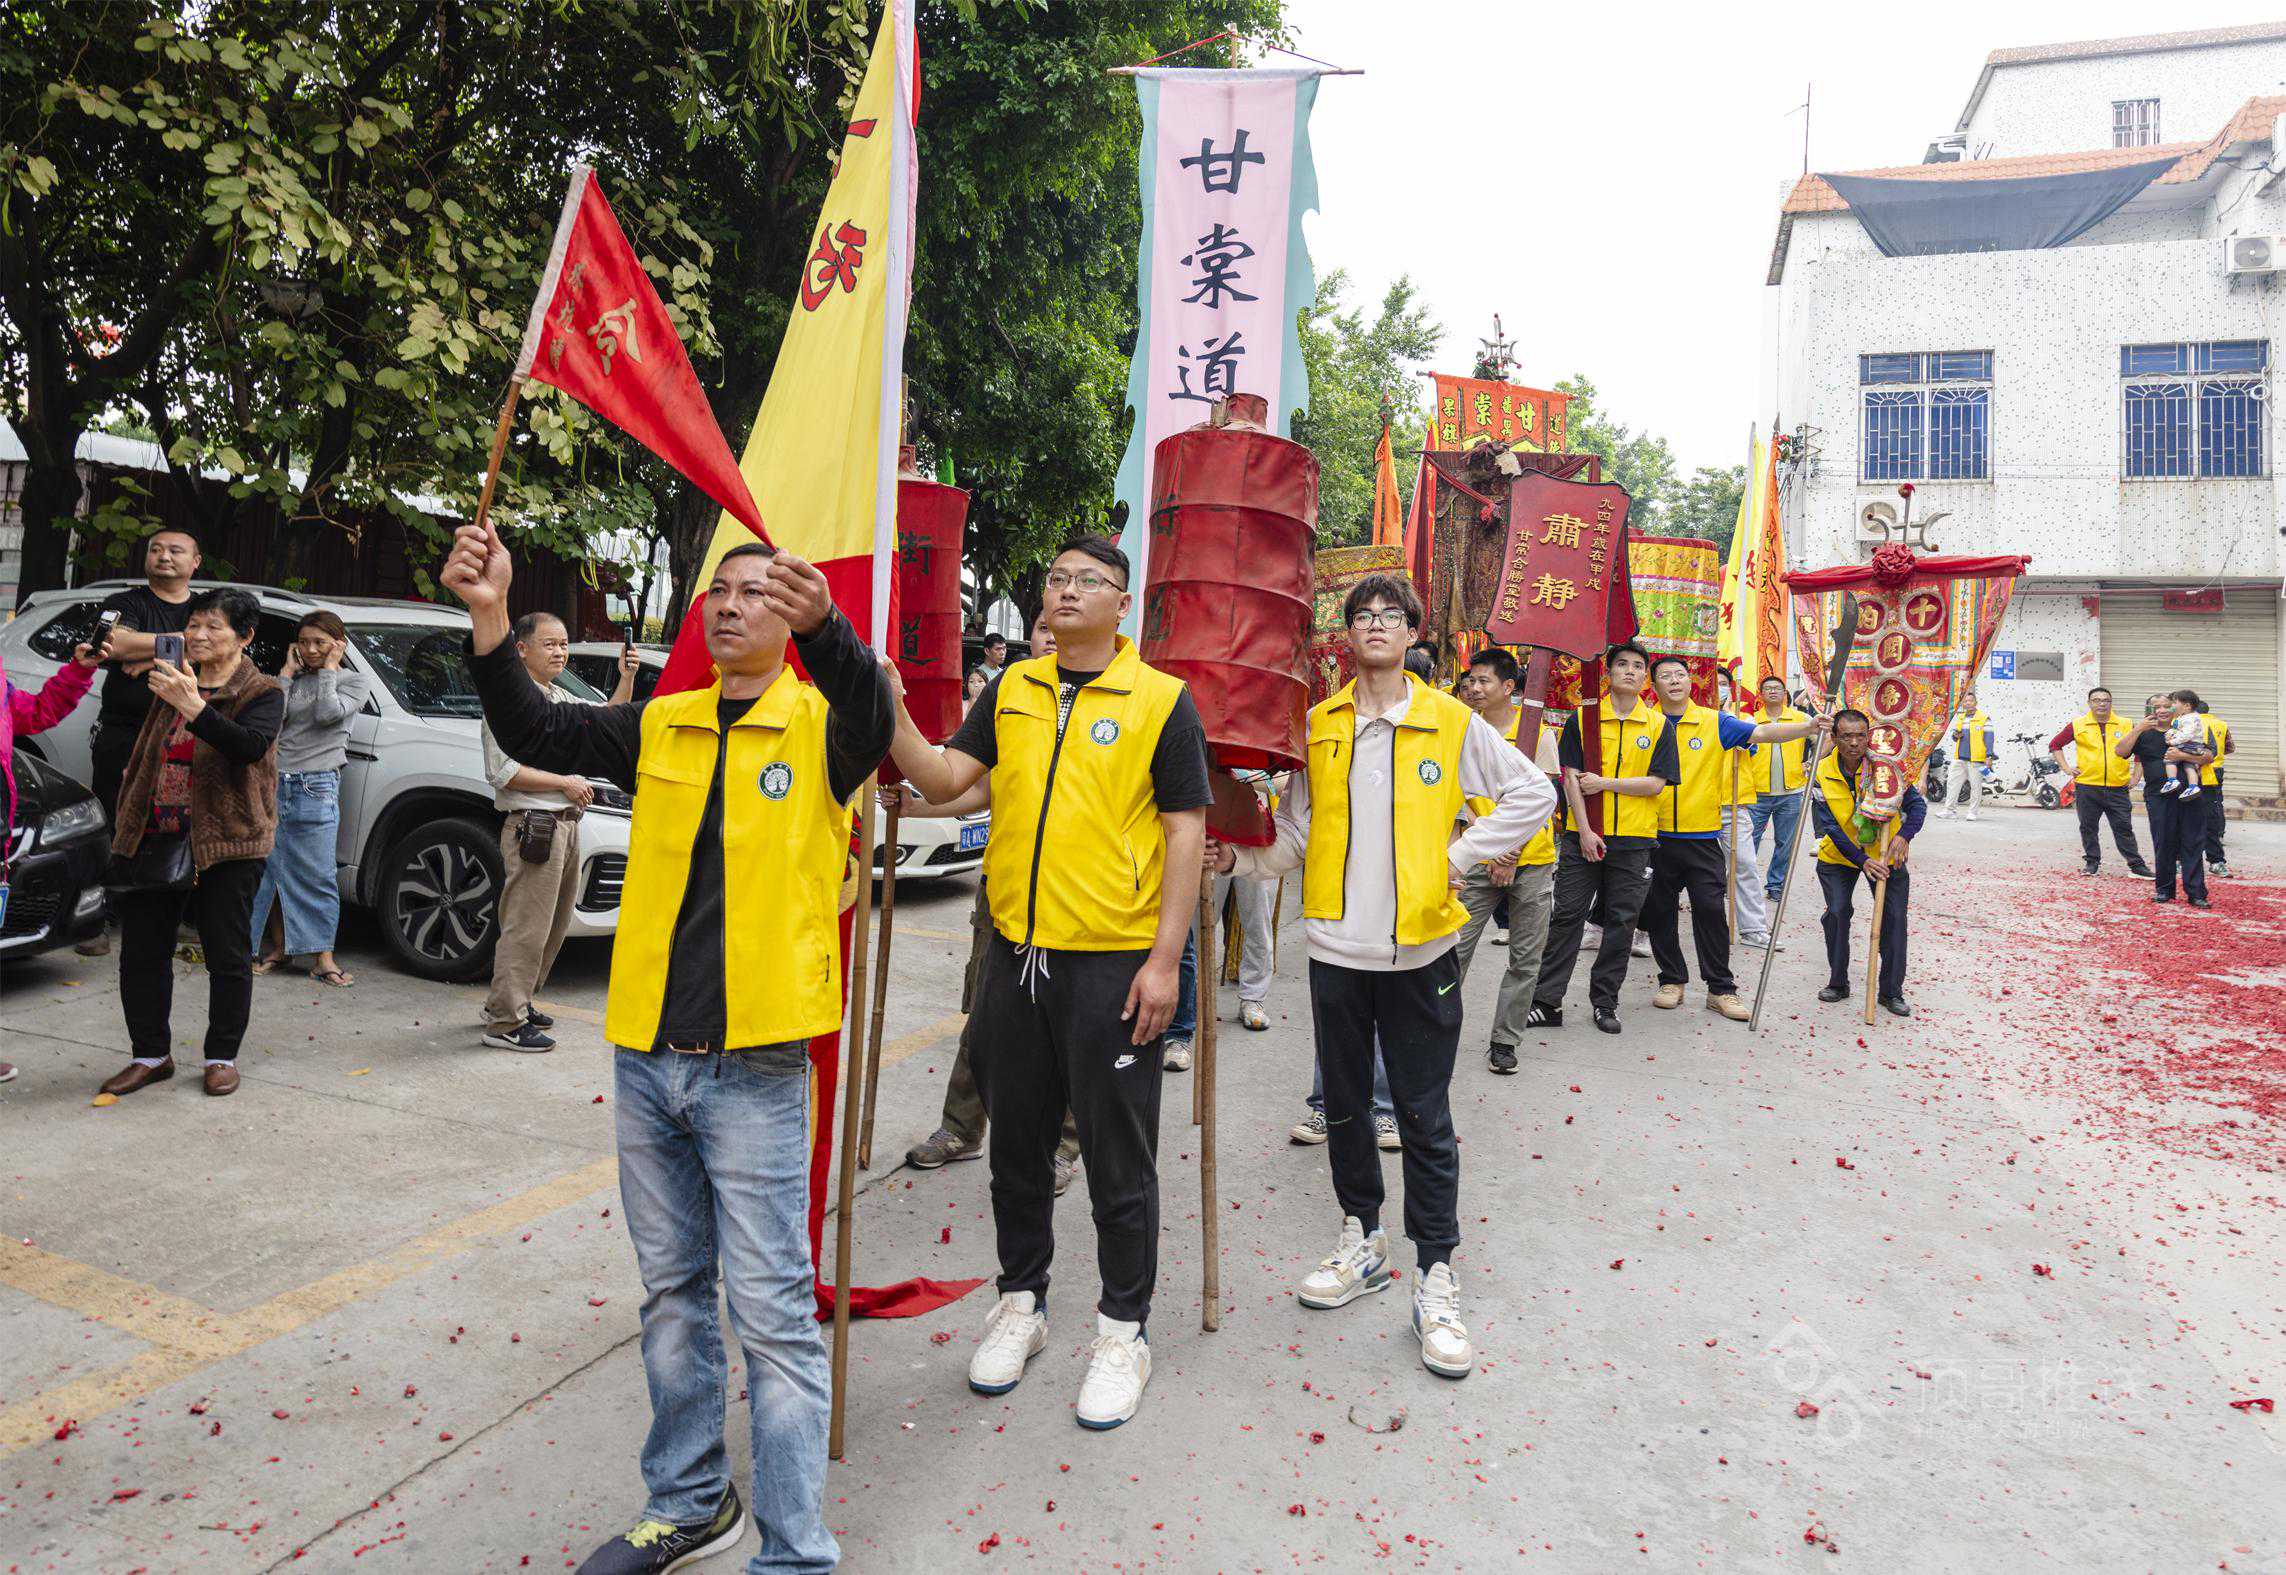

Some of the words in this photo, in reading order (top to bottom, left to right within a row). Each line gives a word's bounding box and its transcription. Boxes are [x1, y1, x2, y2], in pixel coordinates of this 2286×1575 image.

[1168, 128, 1266, 405] 甘棠道
[587, 297, 644, 377] 令
[1474, 391, 1536, 433] 甘棠
